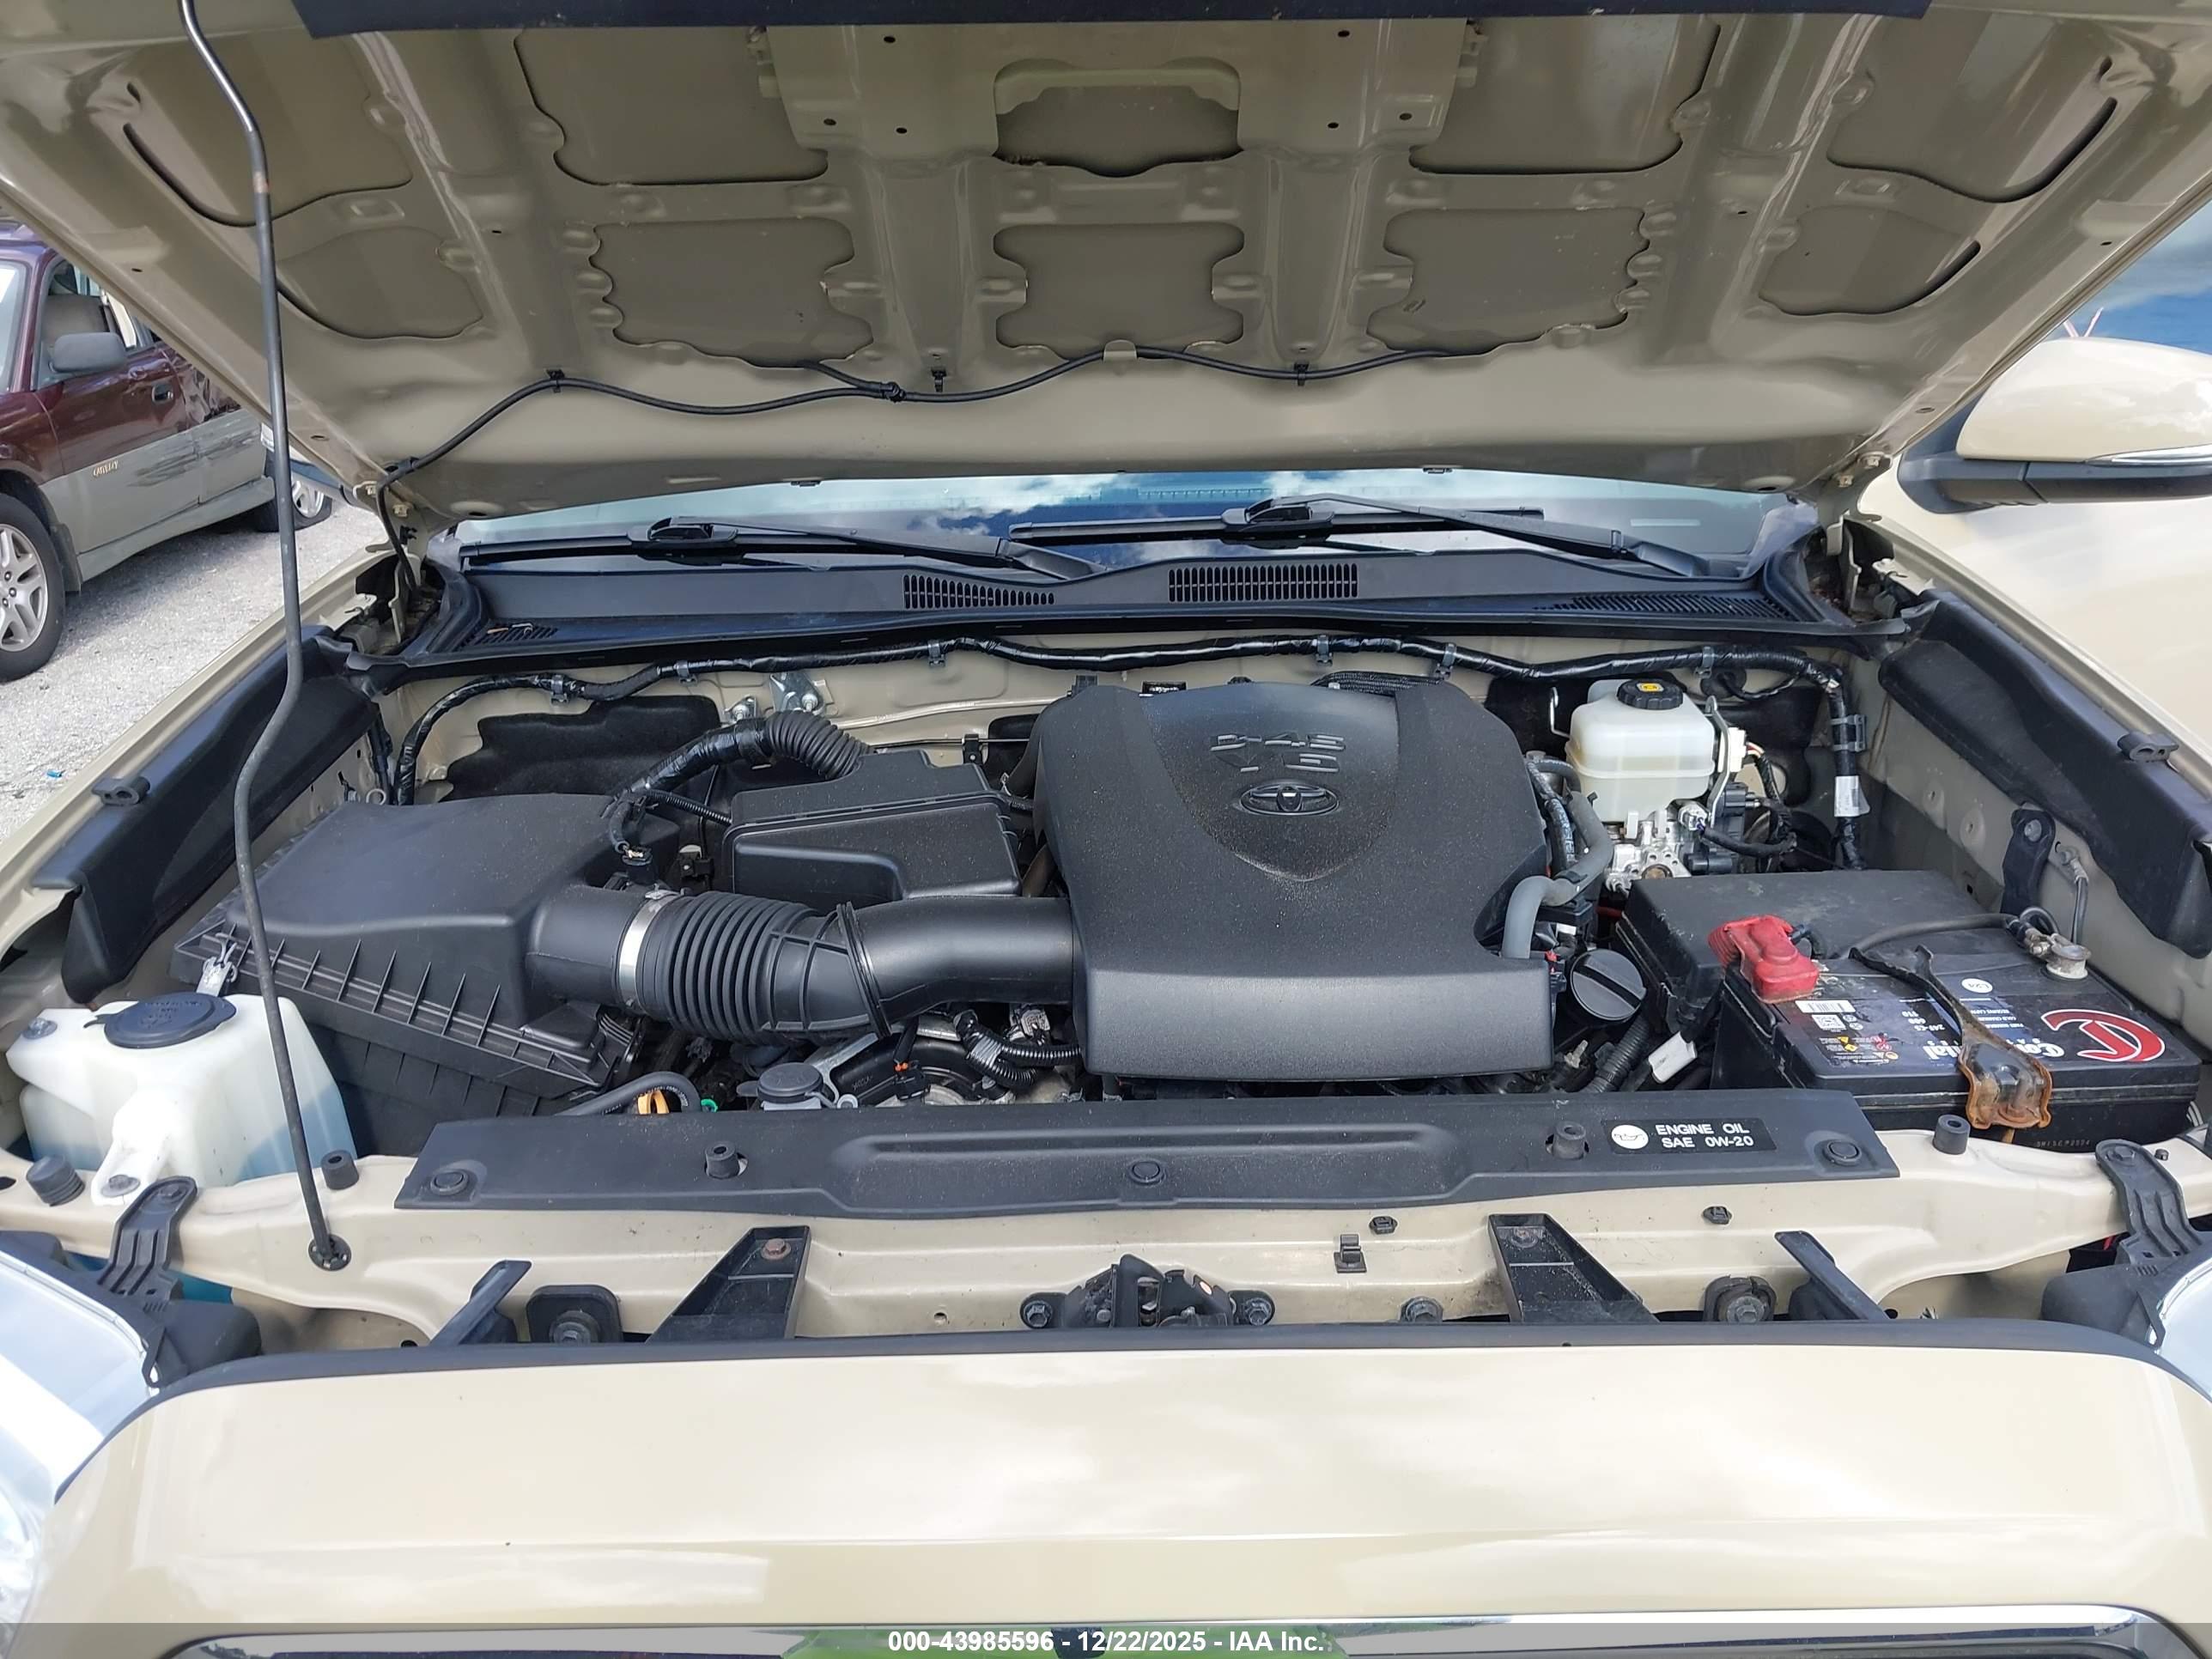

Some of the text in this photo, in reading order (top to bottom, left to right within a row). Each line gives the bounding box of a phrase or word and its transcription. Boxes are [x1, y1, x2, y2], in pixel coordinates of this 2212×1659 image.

[1655, 1123, 1750, 1135] ENGINE OIL
[1661, 1135, 1754, 1148] SAE 0W-20
